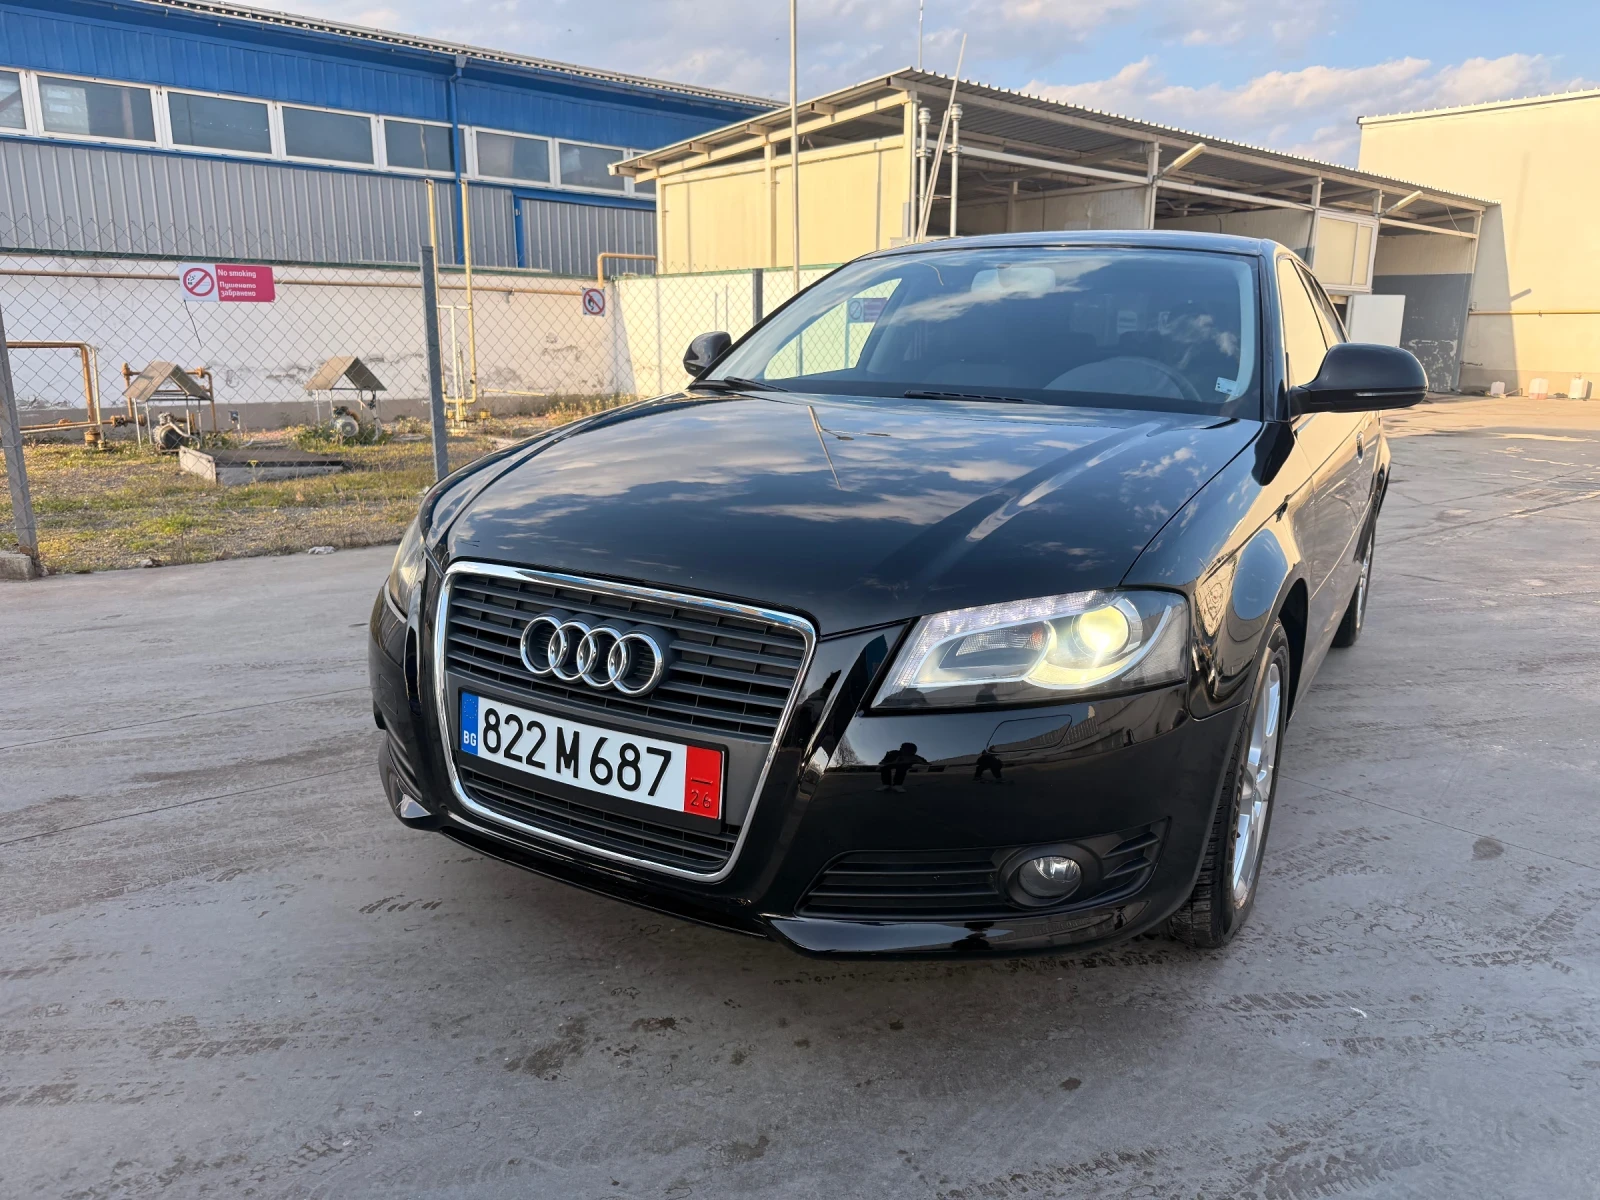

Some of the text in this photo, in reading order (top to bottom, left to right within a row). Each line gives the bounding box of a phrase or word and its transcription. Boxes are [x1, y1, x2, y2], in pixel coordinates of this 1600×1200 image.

[217, 268, 257, 279] No smoking
[463, 730, 477, 747] BG
[482, 707, 672, 797] 822 M 687
